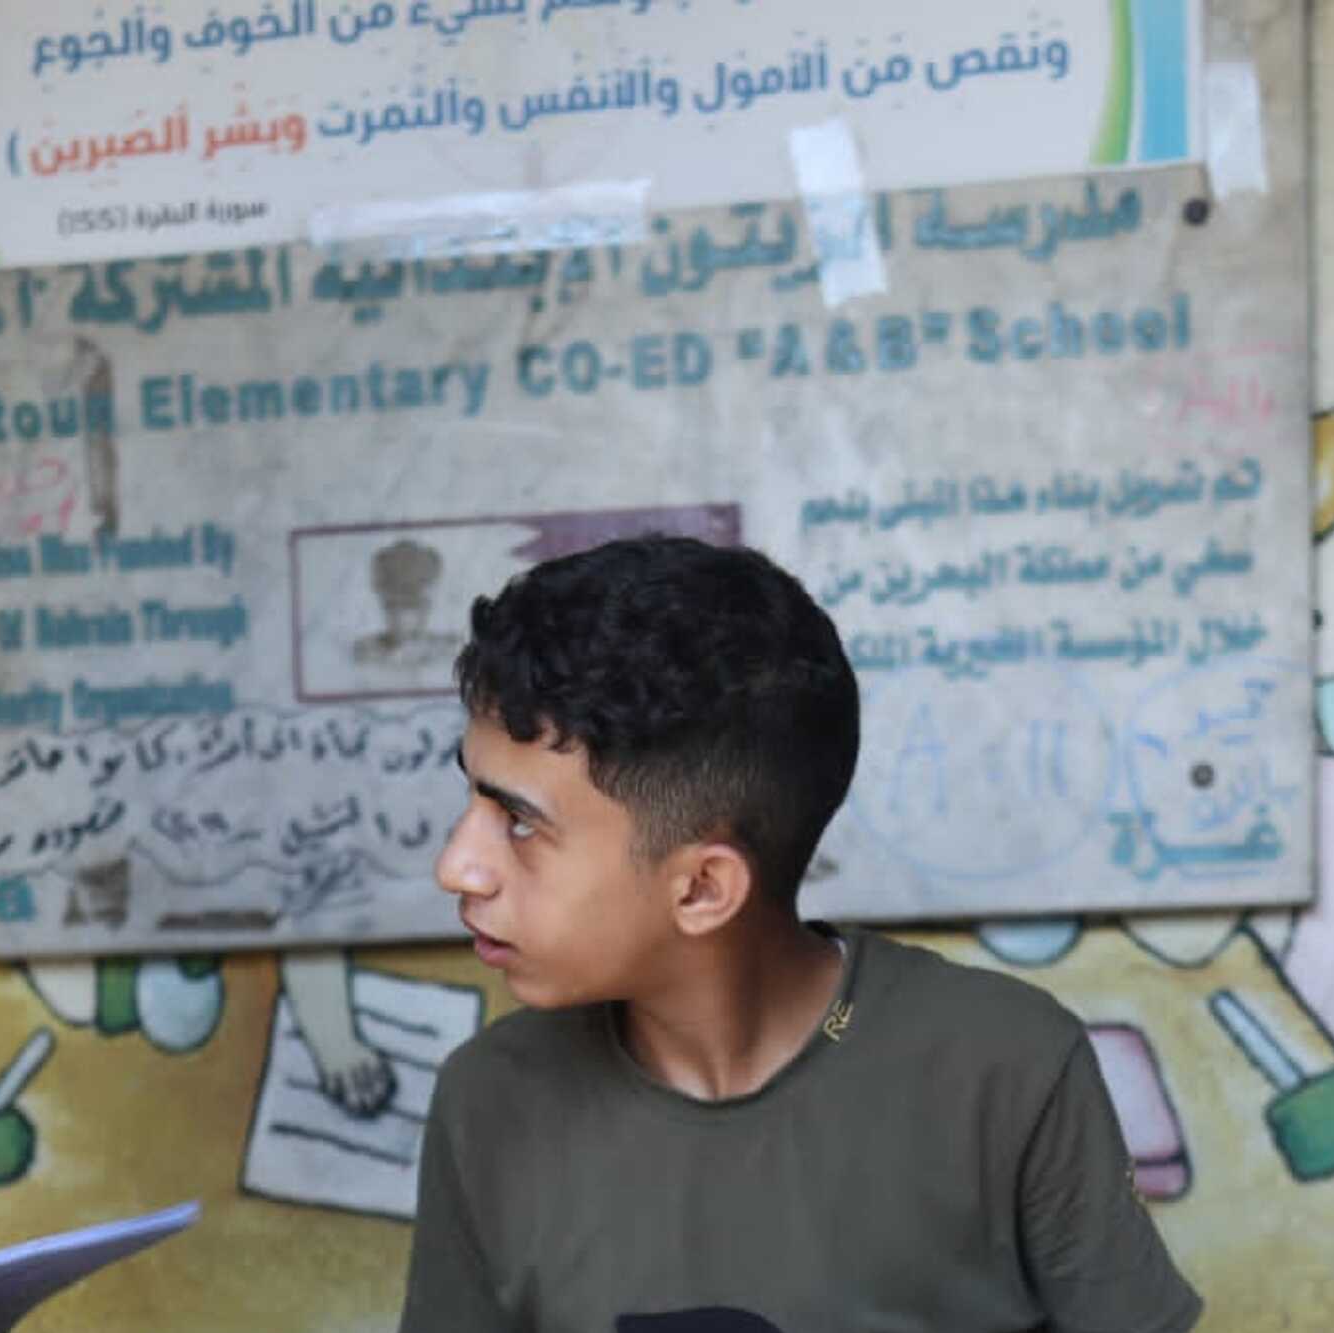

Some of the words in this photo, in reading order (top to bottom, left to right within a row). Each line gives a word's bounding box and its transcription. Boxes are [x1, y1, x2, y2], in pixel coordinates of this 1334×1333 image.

[139, 360, 489, 430] Elementary
[516, 331, 714, 397] CO-ED
[965, 295, 1193, 364] School
